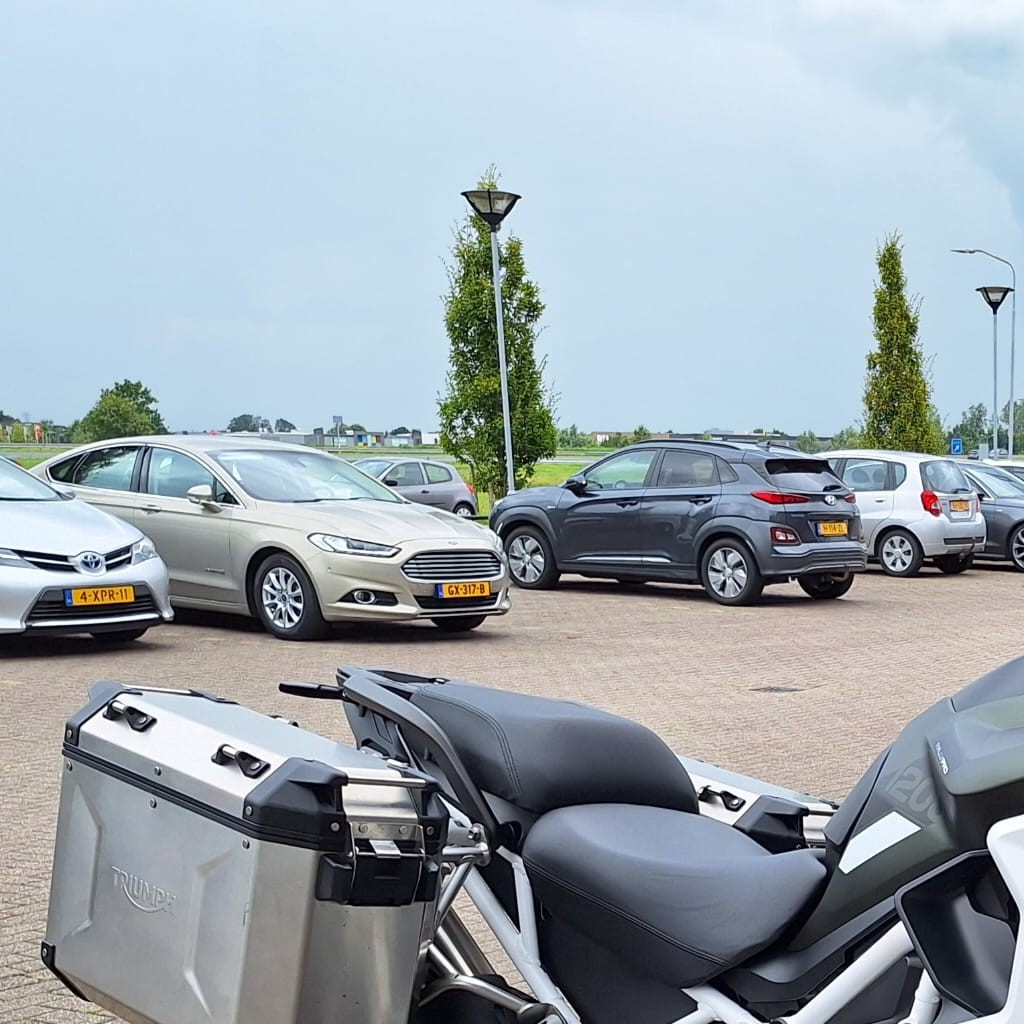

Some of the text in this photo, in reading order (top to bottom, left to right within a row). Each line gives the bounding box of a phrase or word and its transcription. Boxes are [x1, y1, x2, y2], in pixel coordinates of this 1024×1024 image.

[80, 588, 128, 603] 4-XPR-11
[447, 583, 486, 597] GX-317-B
[112, 865, 176, 916] TRIUMPH
